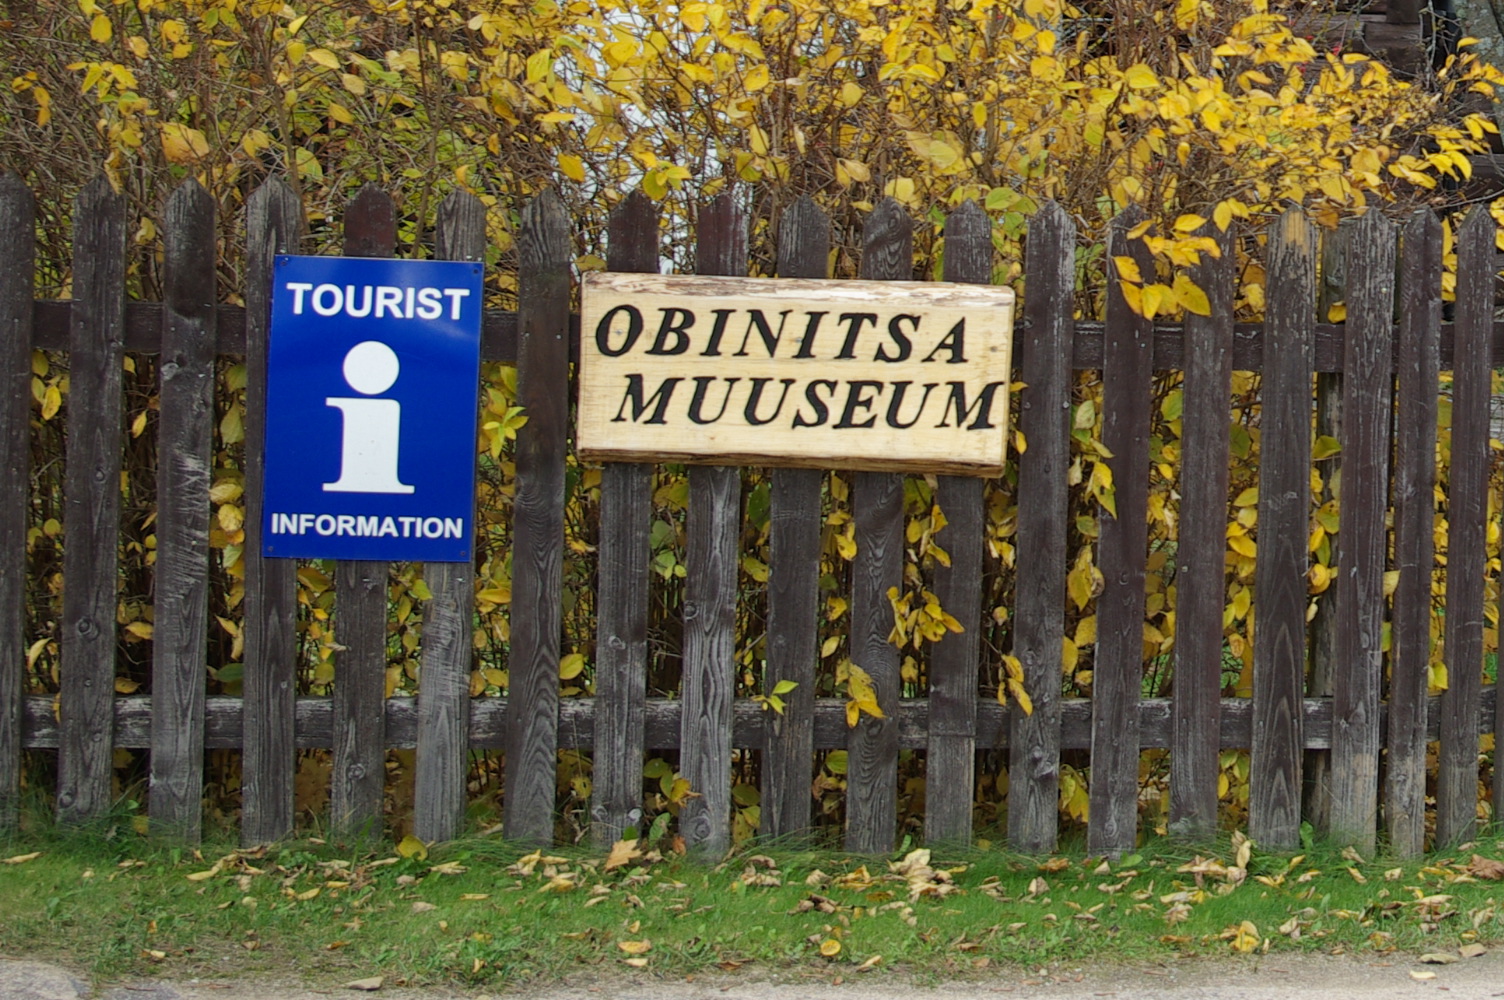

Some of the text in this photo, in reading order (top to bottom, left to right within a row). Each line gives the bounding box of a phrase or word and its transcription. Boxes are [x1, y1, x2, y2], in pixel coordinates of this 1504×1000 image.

[286, 282, 470, 320] TOURIST
[594, 304, 968, 364] OBINITSA
[610, 373, 1006, 431] MUUSEUM
[271, 513, 463, 538] INFORMATION
